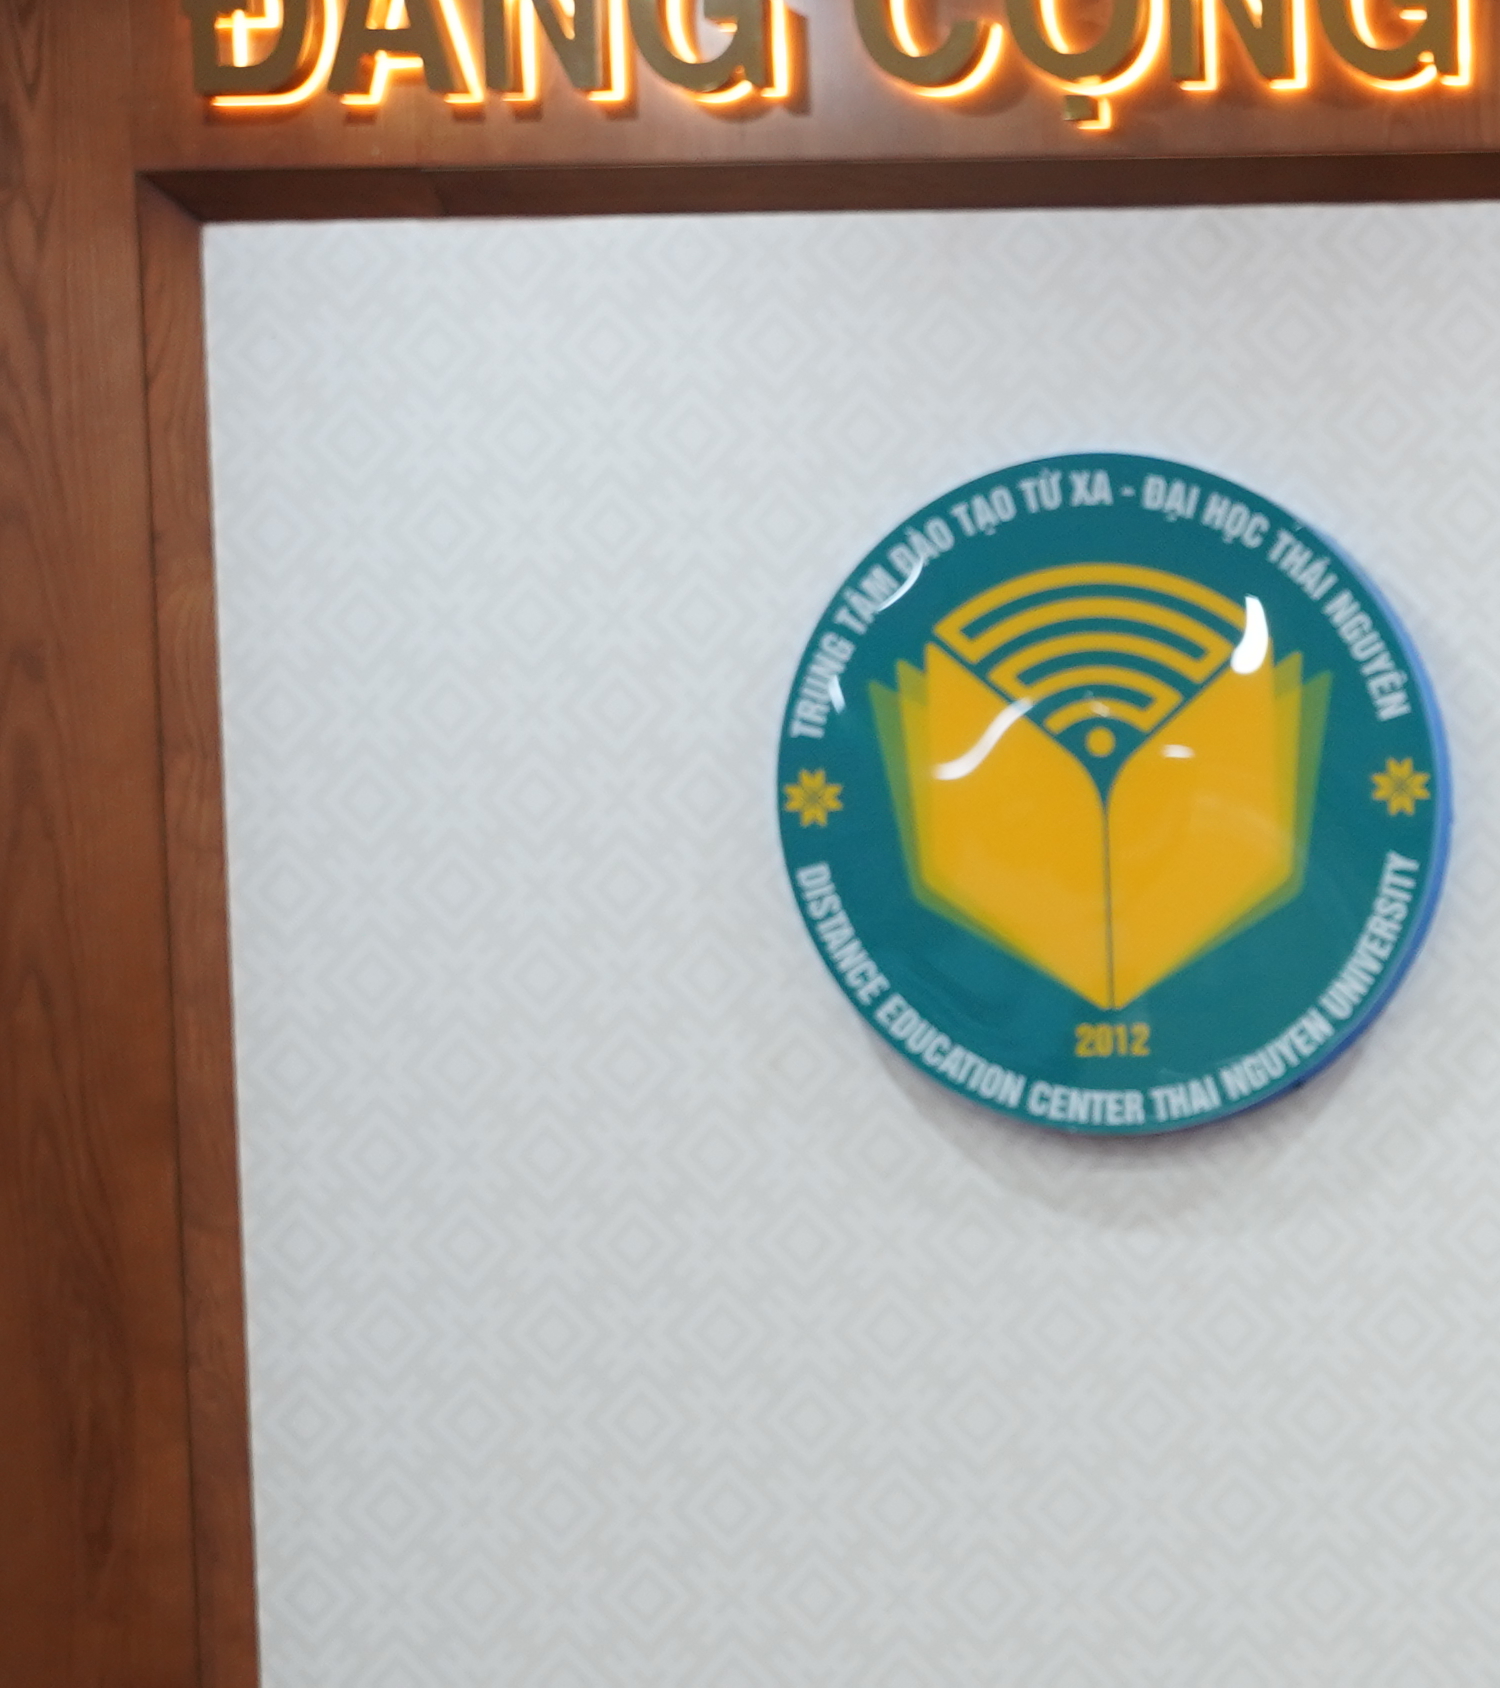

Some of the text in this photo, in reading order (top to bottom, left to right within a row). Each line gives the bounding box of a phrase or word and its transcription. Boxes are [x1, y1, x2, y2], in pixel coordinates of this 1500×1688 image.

[789, 631, 857, 739] TRUNG
[834, 563, 901, 635] TÂM
[887, 516, 956, 577] ĐÀO
[950, 485, 1017, 536] TẠO
[1068, 469, 1114, 507] XA
[1141, 473, 1201, 523] ĐẠI
[1201, 491, 1271, 549] HỌC
[1266, 527, 1339, 601] THÁI
[1321, 588, 1412, 722] NGUYÊN
[796, 849, 1420, 1126] DISTANCE EDUCATION CENTER THAI NGUYEN UNIVERSITY
[1074, 1022, 1152, 1058] 2012
